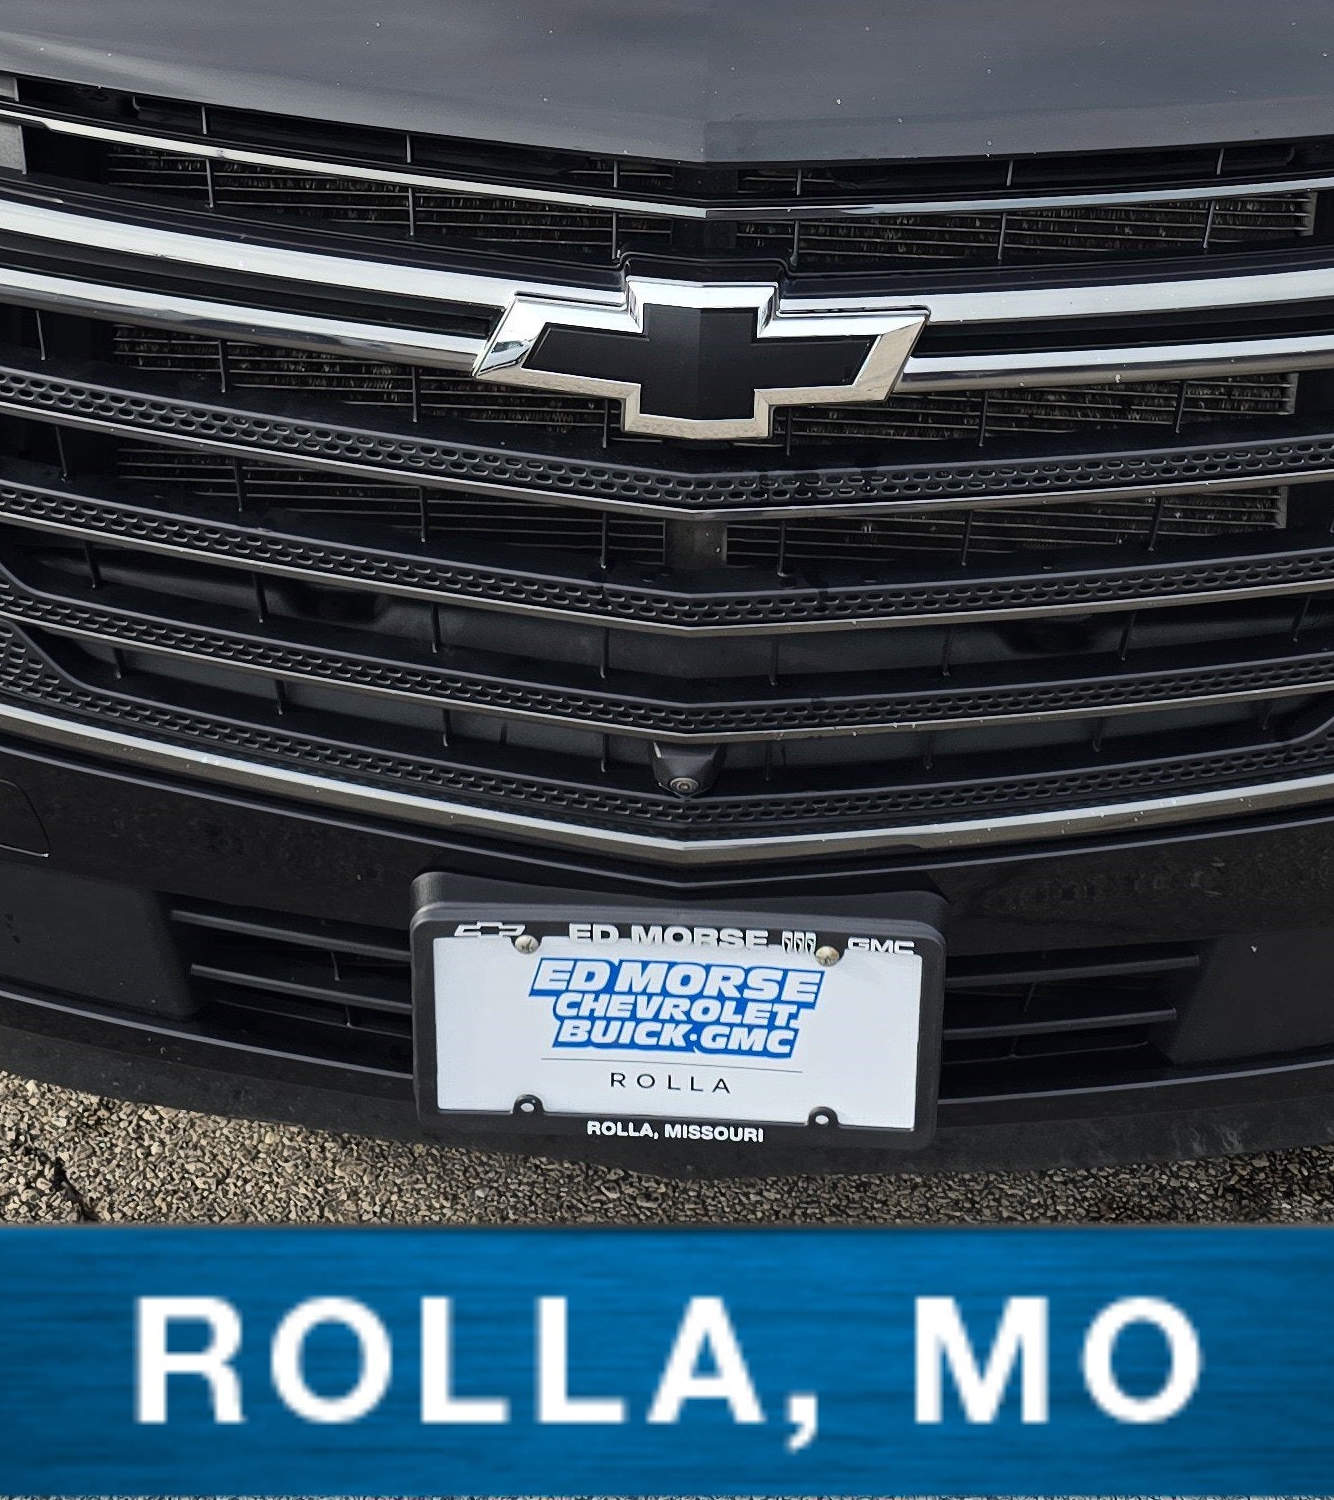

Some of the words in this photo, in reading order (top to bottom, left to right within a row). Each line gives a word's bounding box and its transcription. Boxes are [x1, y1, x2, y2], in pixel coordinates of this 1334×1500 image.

[569, 923, 619, 945] ED
[631, 925, 769, 950] MORSE
[848, 937, 915, 956] GMC
[533, 960, 610, 992] ED
[614, 962, 822, 1002] MORSE
[556, 992, 797, 1027] CHEVROLET
[610, 1072, 730, 1094] ROLLA
[587, 1120, 659, 1139] ROLLA,
[664, 1123, 764, 1142] MISSOURI
